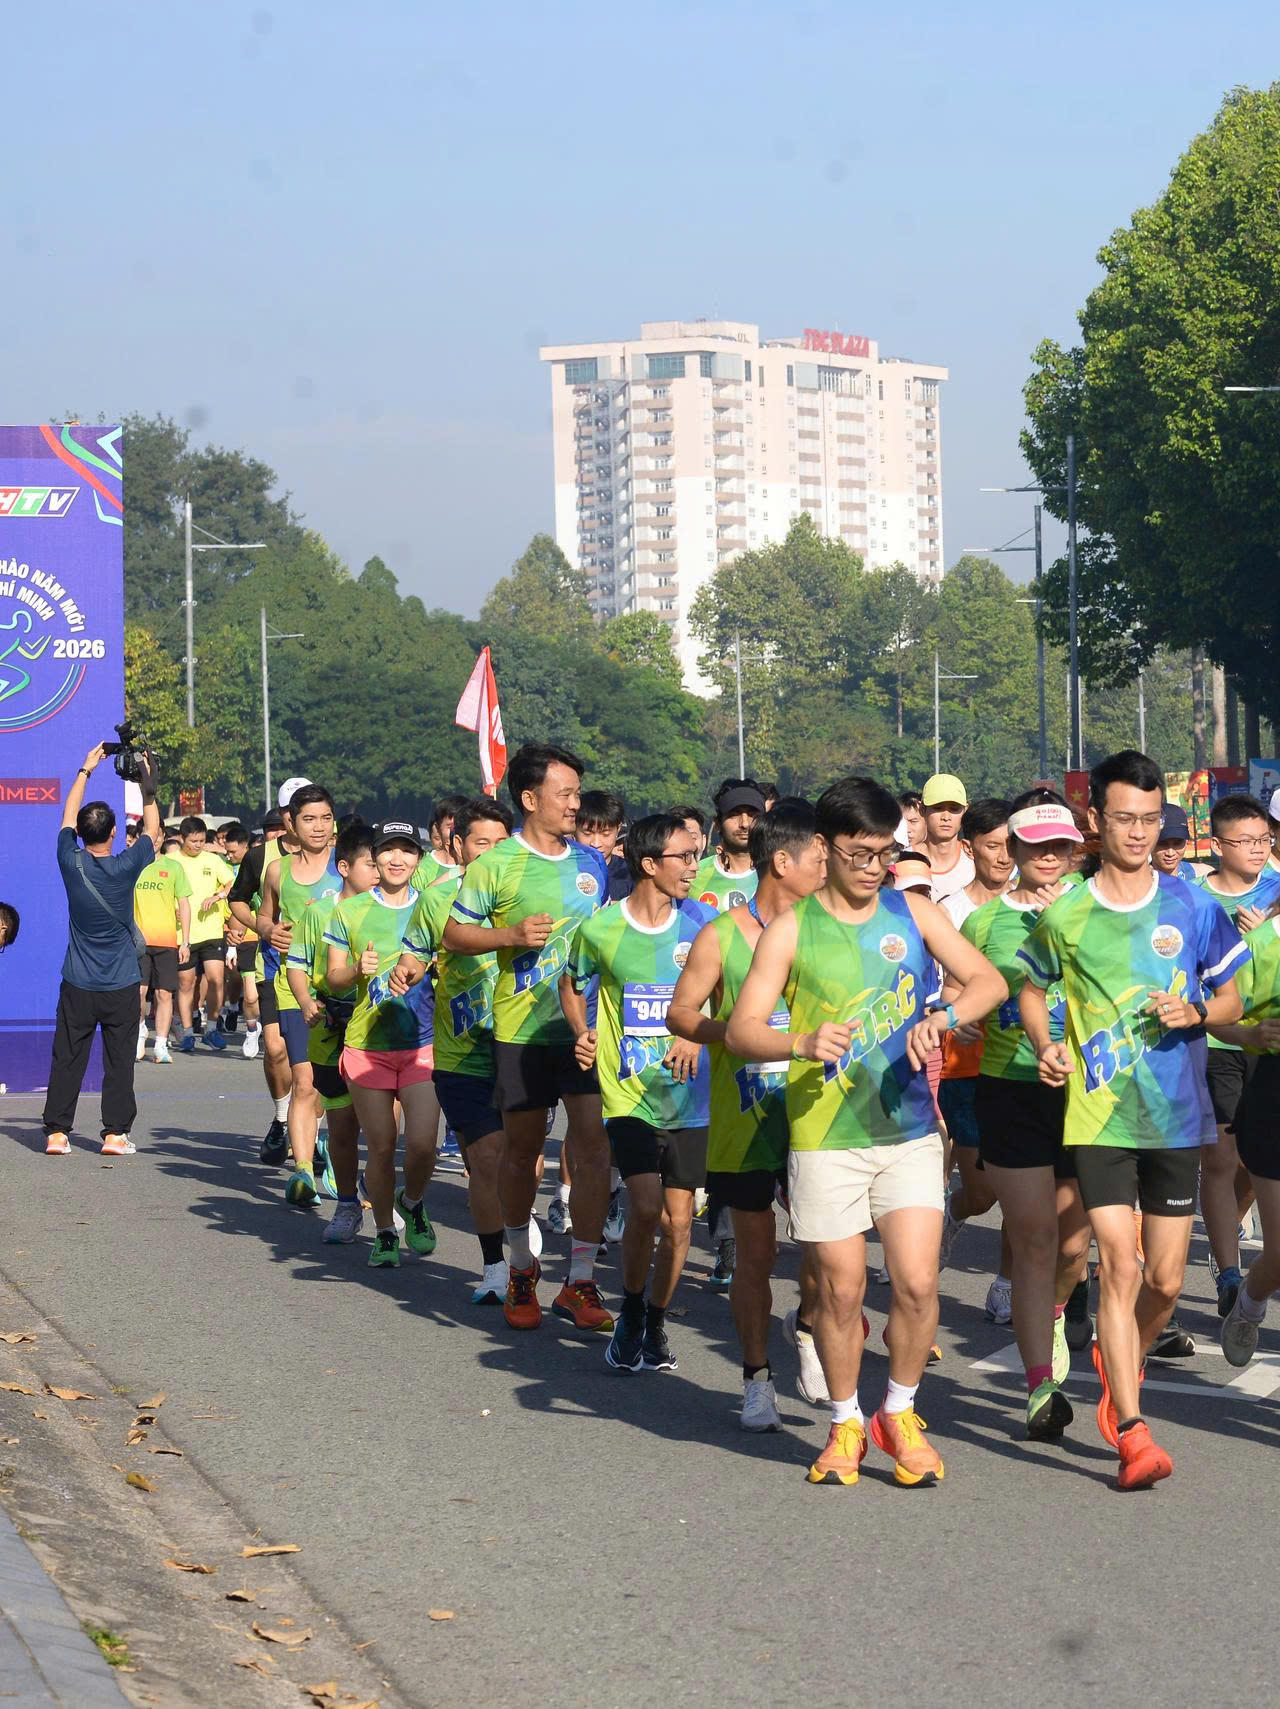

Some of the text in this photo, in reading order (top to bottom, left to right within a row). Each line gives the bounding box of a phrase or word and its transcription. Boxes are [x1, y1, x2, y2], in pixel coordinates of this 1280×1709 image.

[0, 492, 73, 511] HTV
[16, 586, 56, 621] MINH
[30, 569, 67, 602] NĂM
[59, 598, 86, 633] MỚI
[53, 639, 105, 659] 2026
